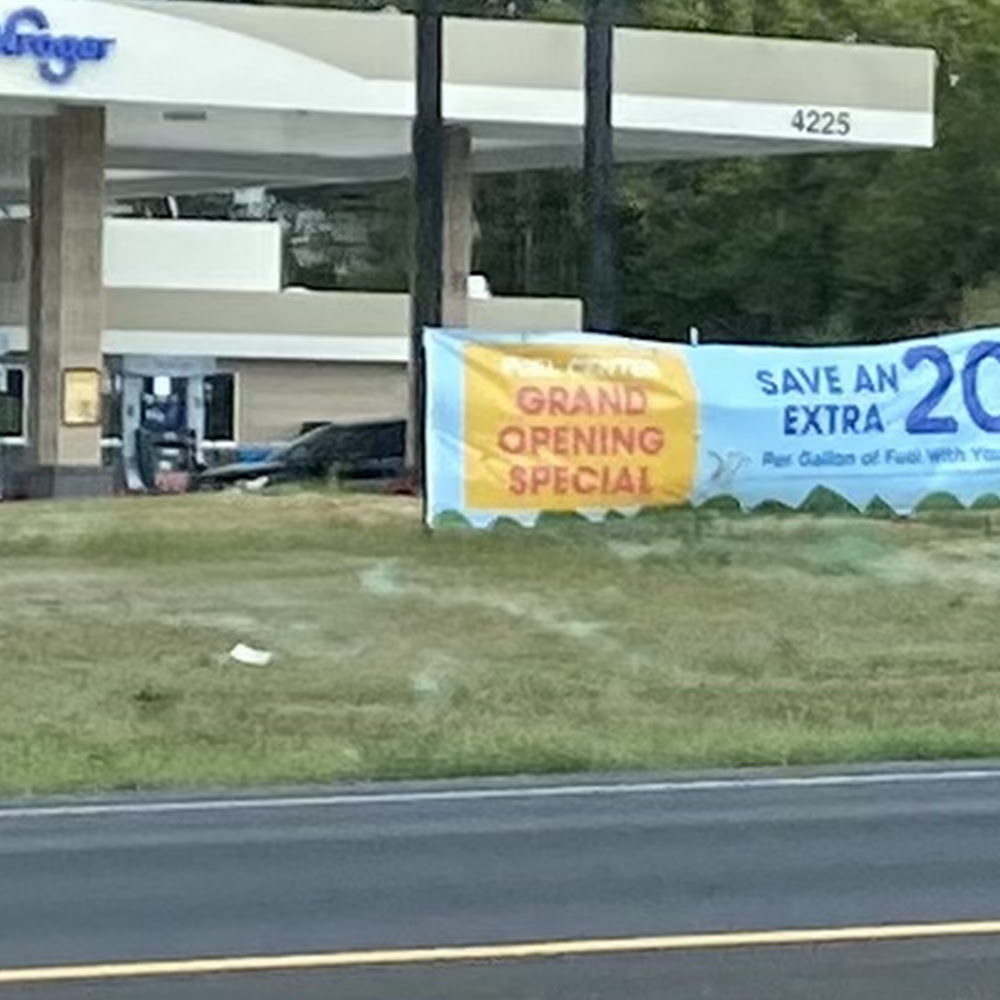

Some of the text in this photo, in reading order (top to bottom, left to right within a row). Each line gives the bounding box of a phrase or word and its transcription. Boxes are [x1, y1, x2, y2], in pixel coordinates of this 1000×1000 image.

[791, 109, 850, 136] 4225
[756, 363, 899, 395] SAVE AN
[516, 385, 648, 416] GRAND
[783, 403, 885, 436] EXTRA
[498, 425, 665, 456] OPENING
[761, 450, 792, 468] Per
[798, 449, 856, 468] Gallon
[509, 465, 653, 496] SPECIAL
